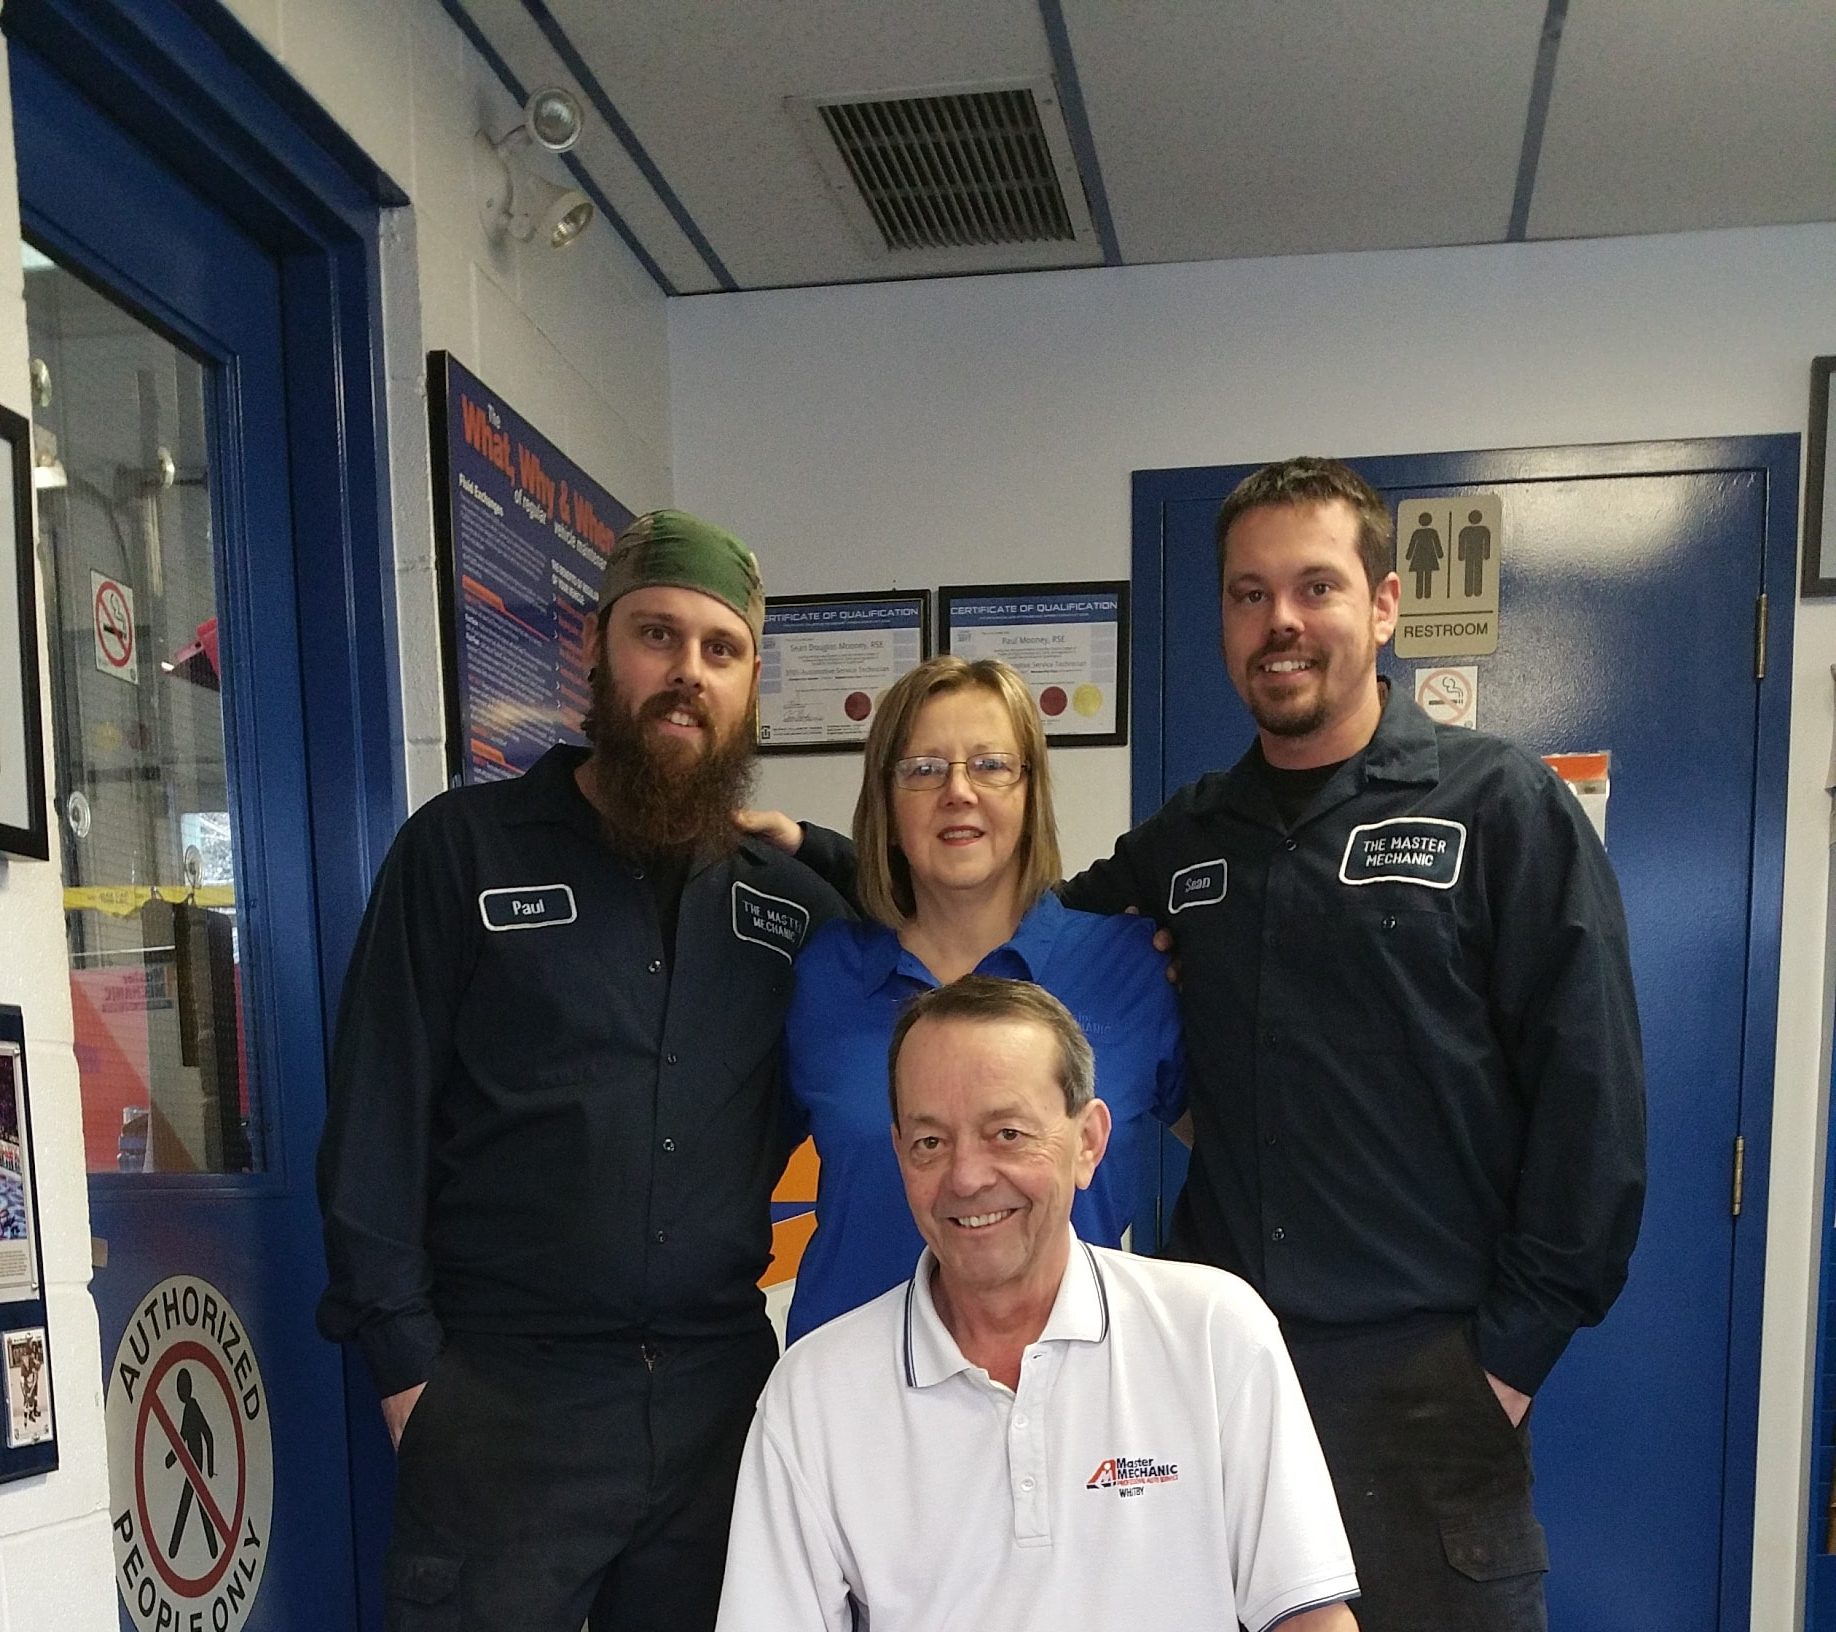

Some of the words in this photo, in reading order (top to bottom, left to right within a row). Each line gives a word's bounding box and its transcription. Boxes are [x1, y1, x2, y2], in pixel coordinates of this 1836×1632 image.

[764, 612, 820, 623] ERTIFICATE
[823, 611, 837, 621] OF
[840, 608, 919, 620] QUALIFICATION
[950, 604, 1018, 616] CERTIFICATE
[1020, 604, 1035, 613] OF
[1036, 601, 1118, 612] QUALIFICATION
[1403, 621, 1489, 639] RESTROOM
[1363, 838, 1387, 854] THE
[1390, 836, 1447, 855] MASTER
[1365, 852, 1435, 868] MECHANIC
[1184, 875, 1211, 894] Sean
[511, 898, 545, 917] Paul
[741, 899, 763, 917] THE
[752, 915, 796, 944] MECHANIC
[118, 1286, 260, 1422] AUTHORIZED
[1116, 1458, 1154, 1469] Master
[1117, 1464, 1178, 1480] MECHANIC
[1119, 1487, 1144, 1498] WHITBY
